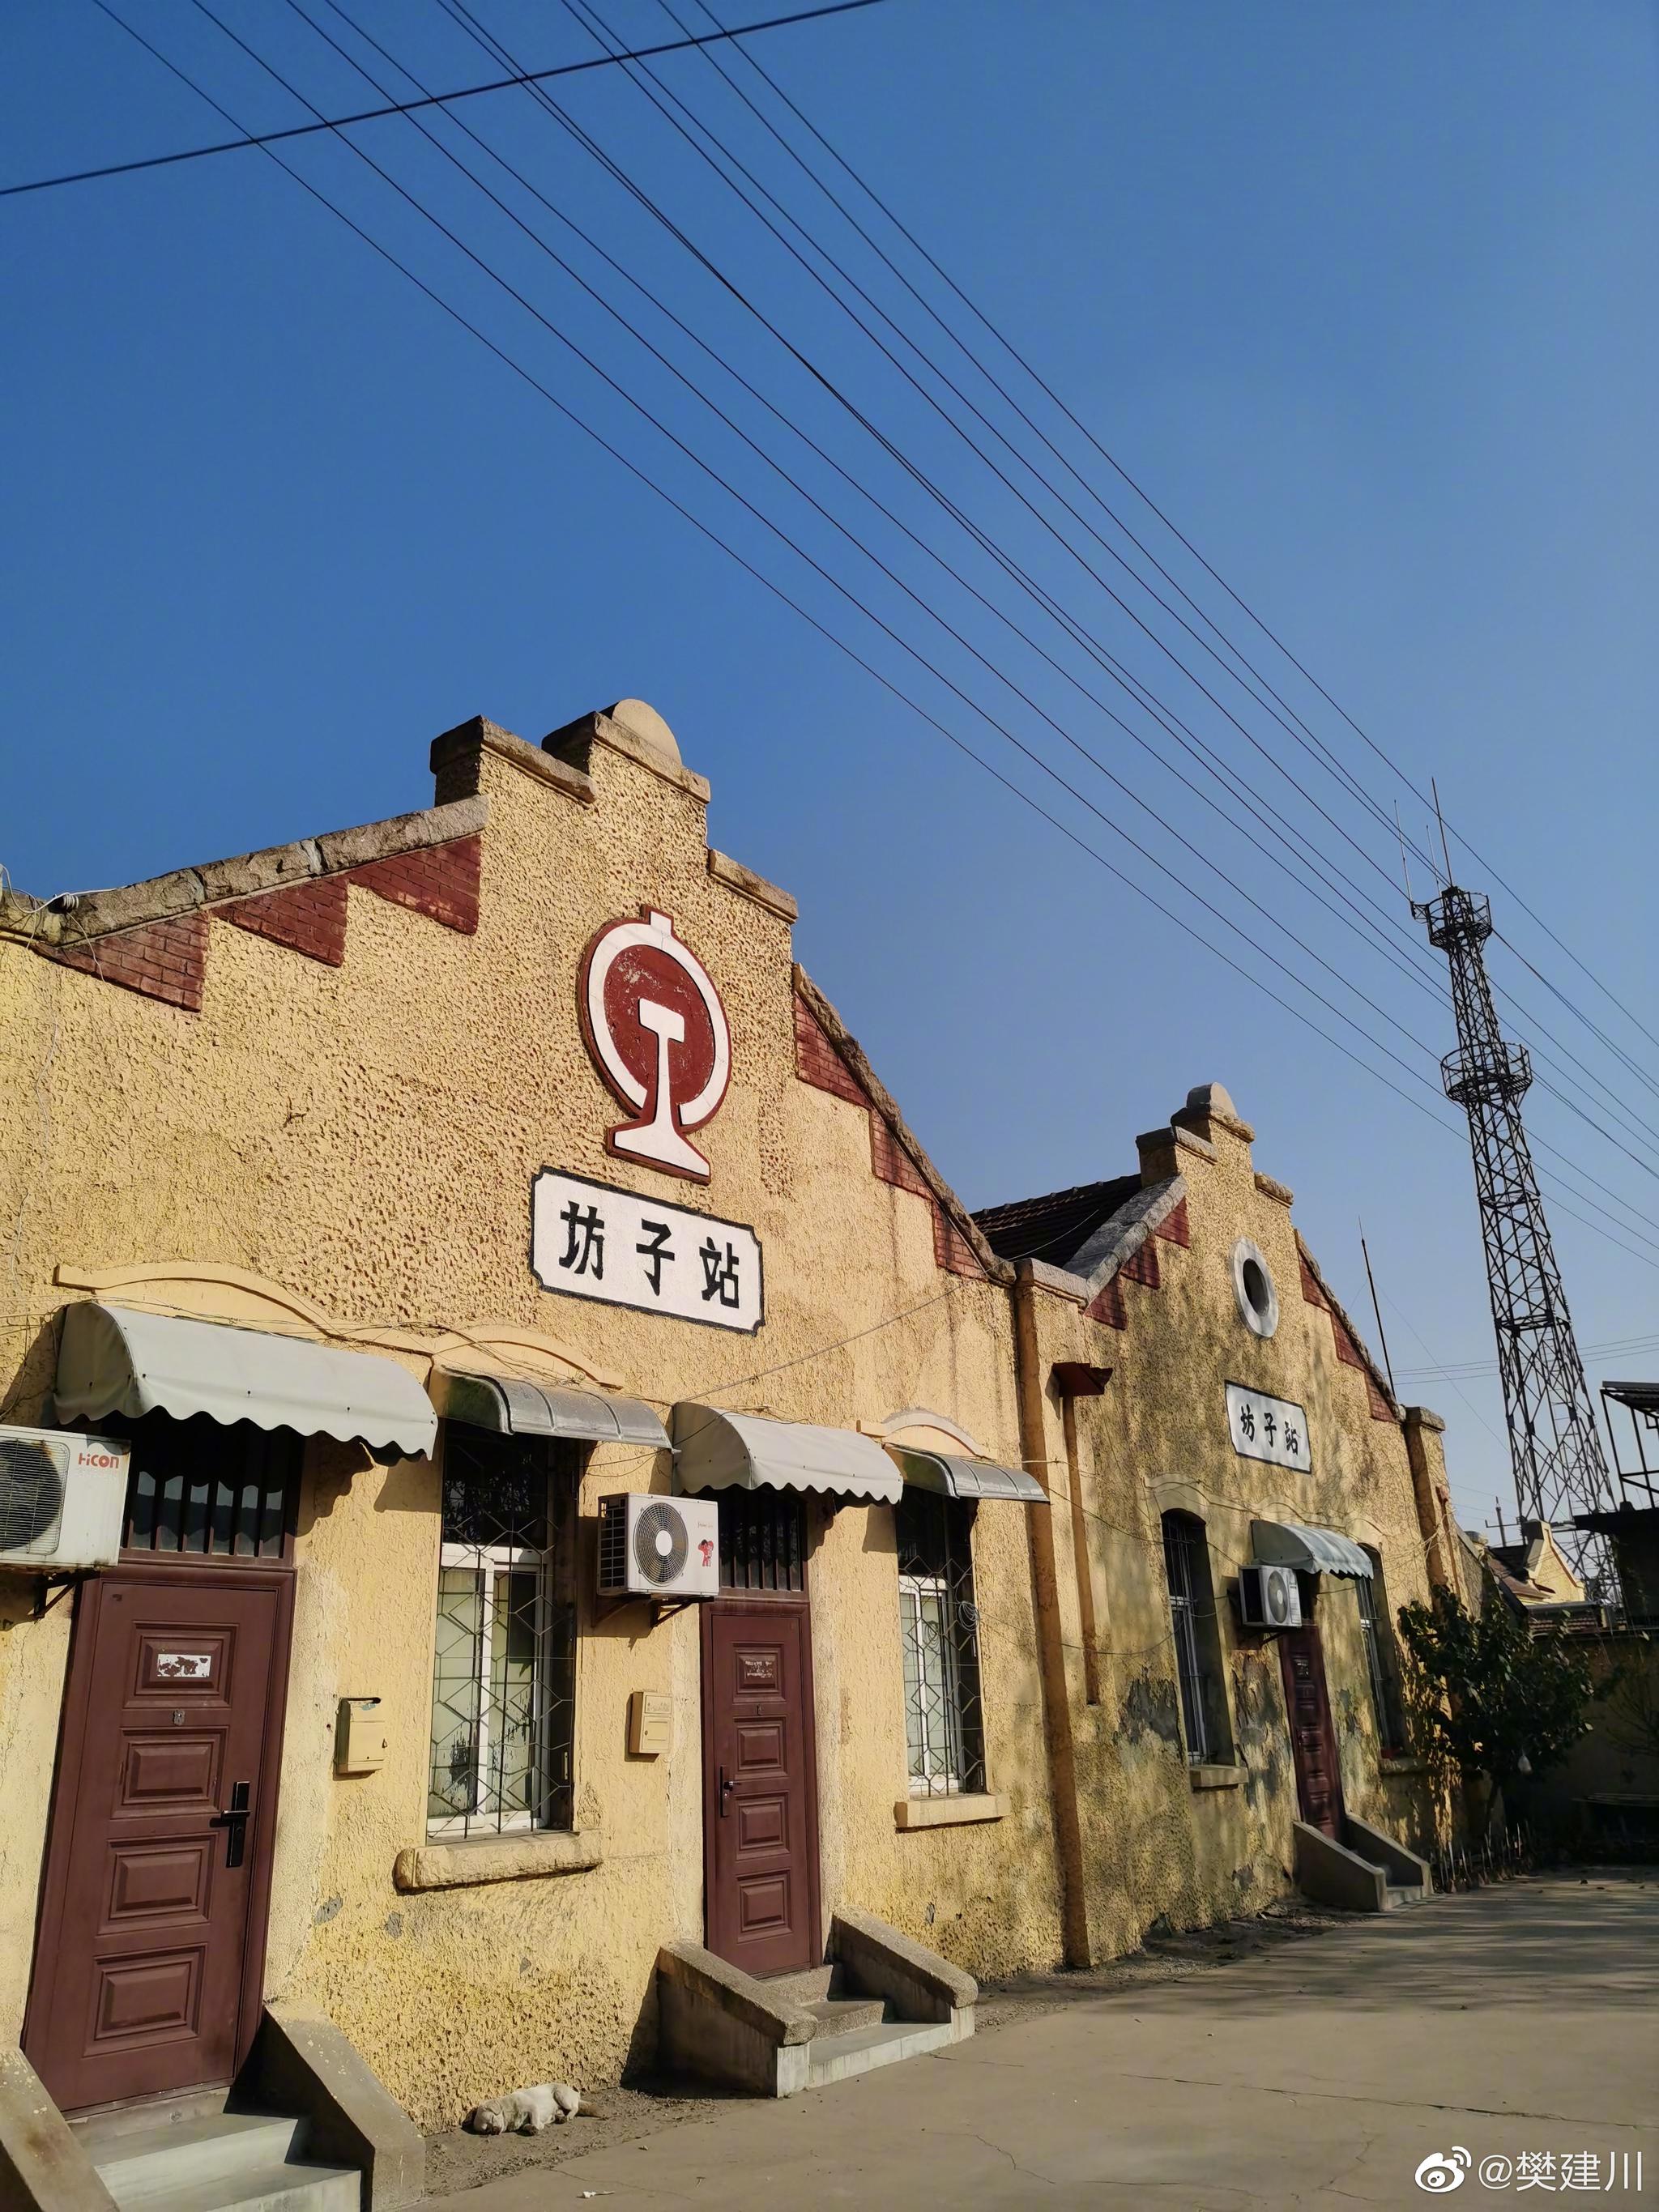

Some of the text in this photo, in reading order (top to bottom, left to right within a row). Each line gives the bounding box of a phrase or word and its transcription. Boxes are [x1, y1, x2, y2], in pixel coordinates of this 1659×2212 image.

[559, 1200, 739, 1309] 坊子站
[1240, 1404, 1299, 1455] 坊子站
